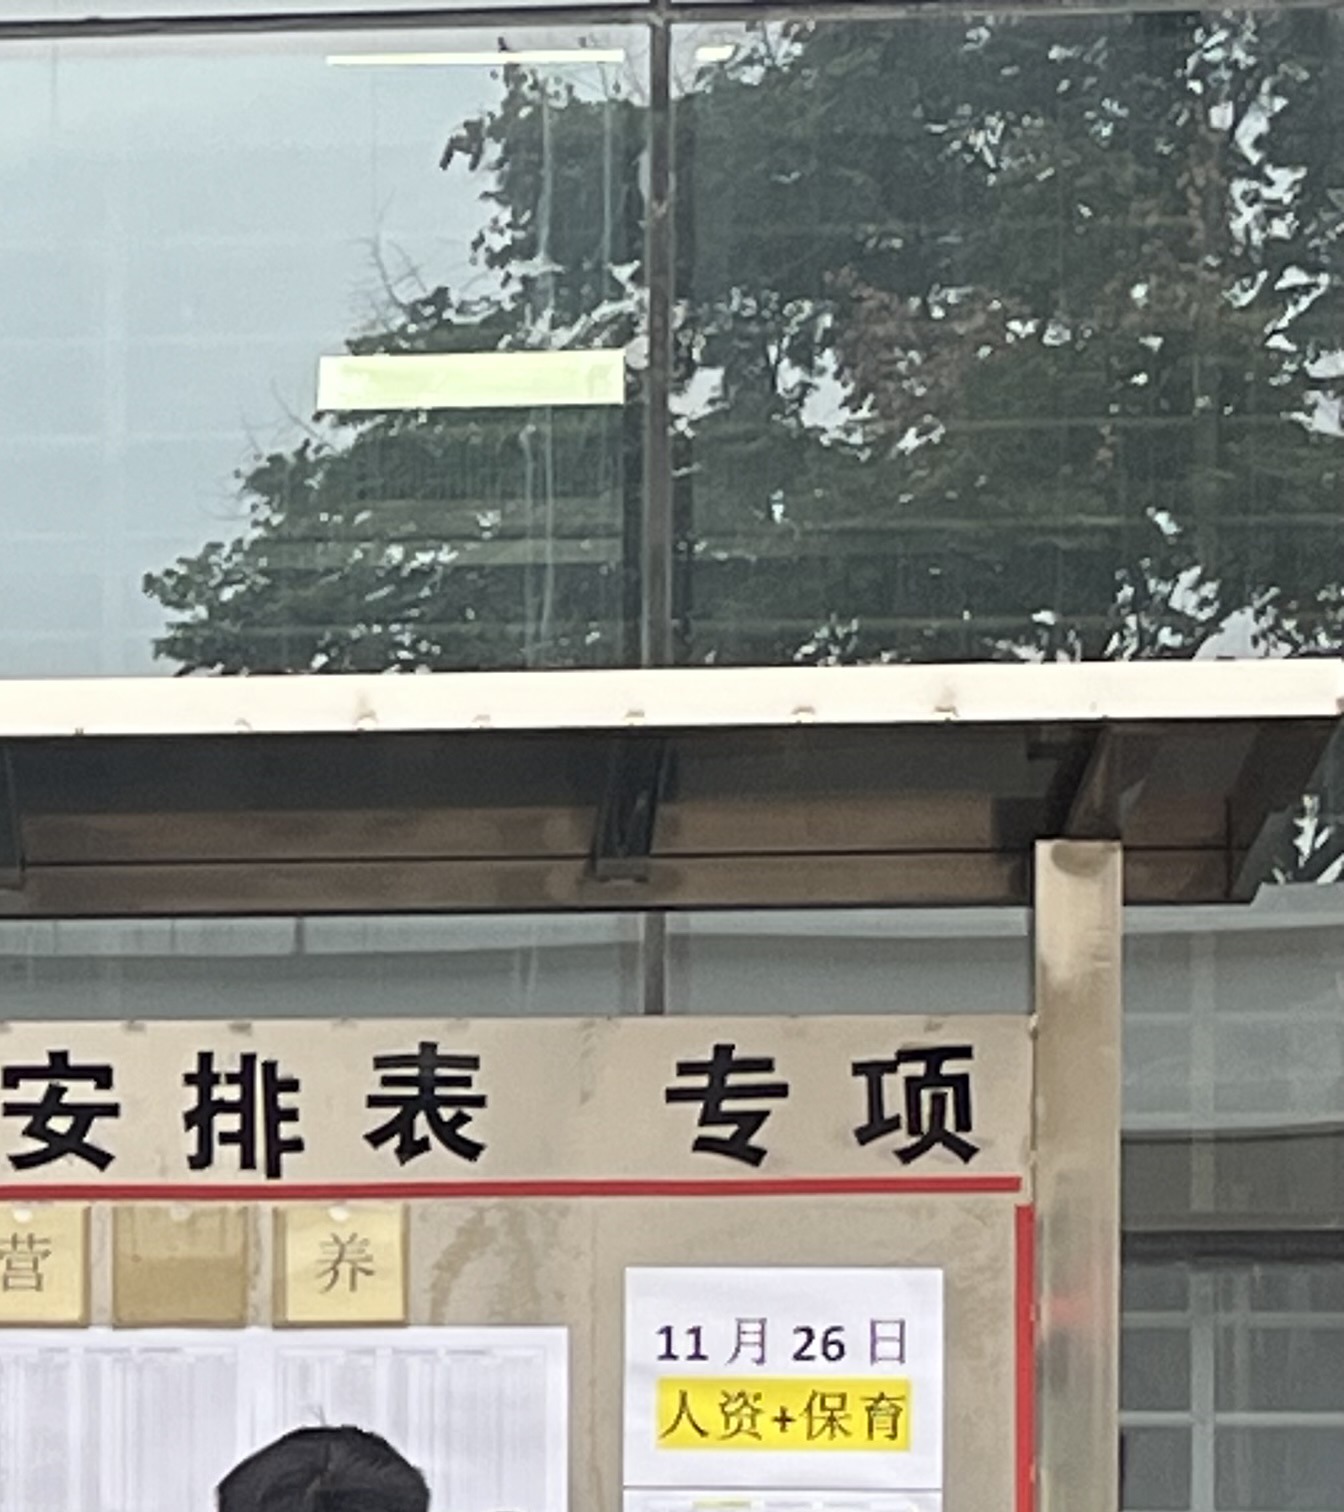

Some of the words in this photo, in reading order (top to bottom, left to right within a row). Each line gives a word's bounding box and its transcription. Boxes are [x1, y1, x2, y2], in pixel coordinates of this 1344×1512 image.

[665, 1041, 980, 1166] 专项
[658, 1389, 907, 1440] 人资+保育
